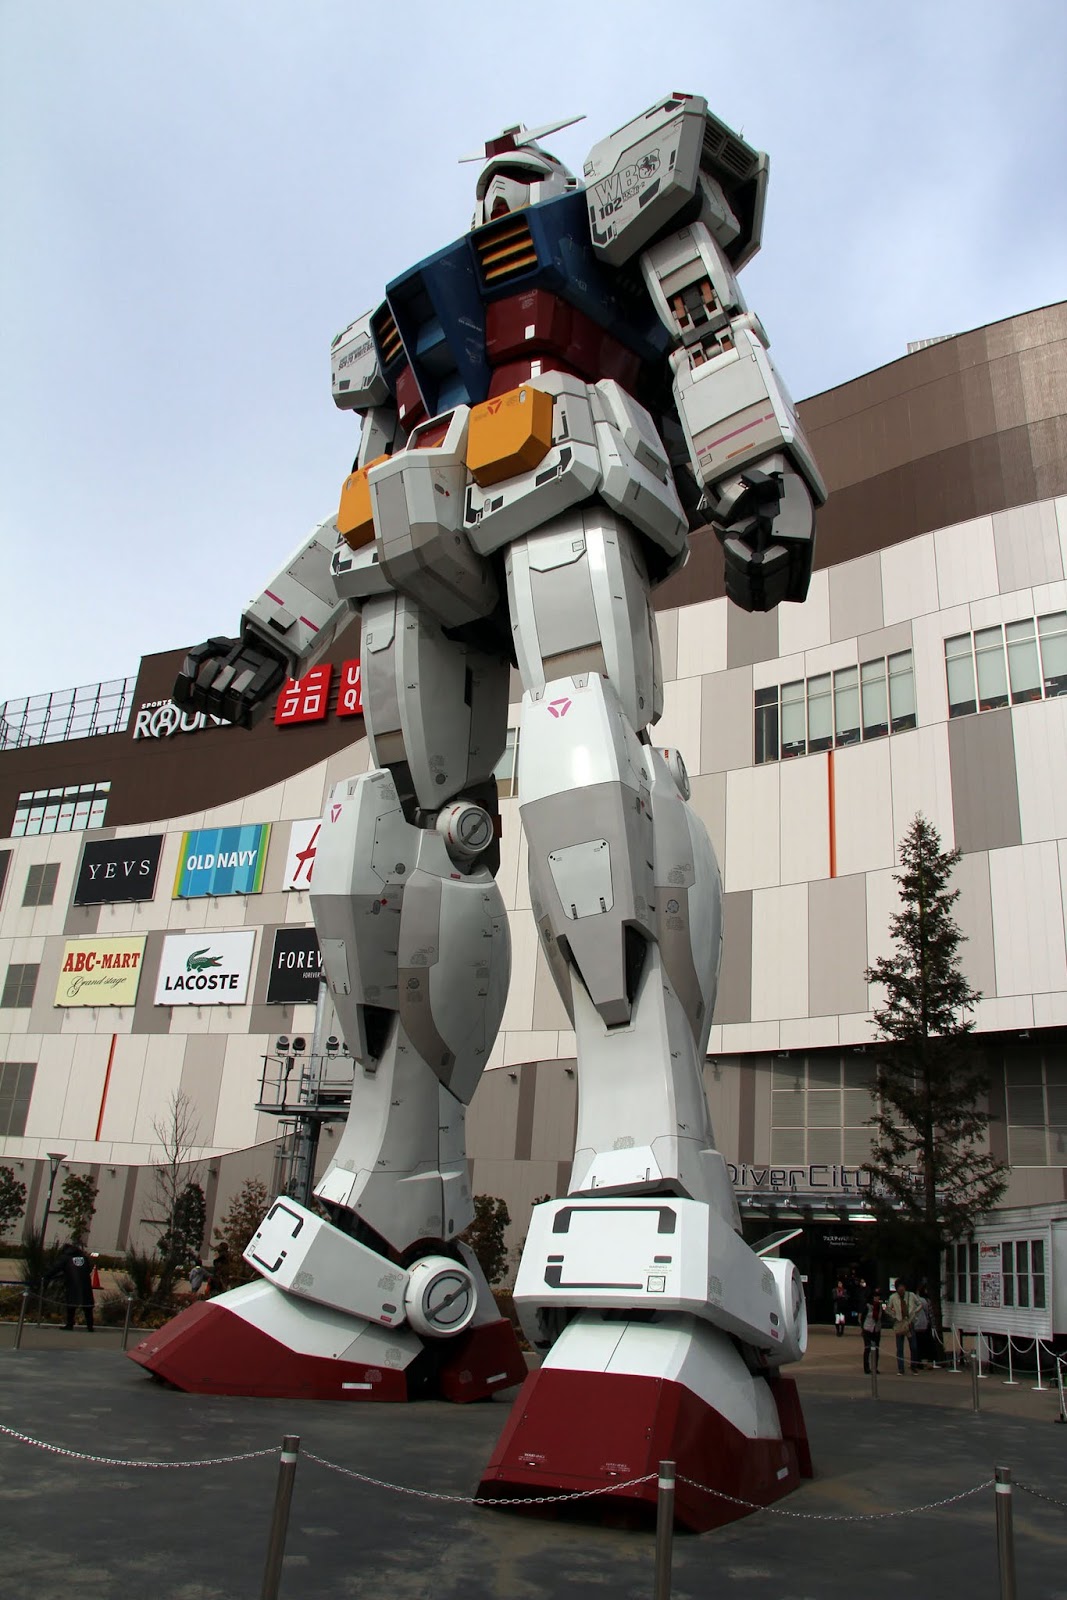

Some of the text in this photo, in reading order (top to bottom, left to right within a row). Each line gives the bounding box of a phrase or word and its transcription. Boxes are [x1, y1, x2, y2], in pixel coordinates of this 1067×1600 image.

[599, 197, 623, 220] 102
[141, 699, 172, 710] SPORTS
[89, 859, 151, 880] YEVS
[186, 849, 258, 871] OLD NAVY
[62, 952, 141, 972] ABC-MART
[278, 950, 323, 969] FOREV
[66, 975, 107, 998] Grand
[165, 974, 240, 991] LACOSTE
